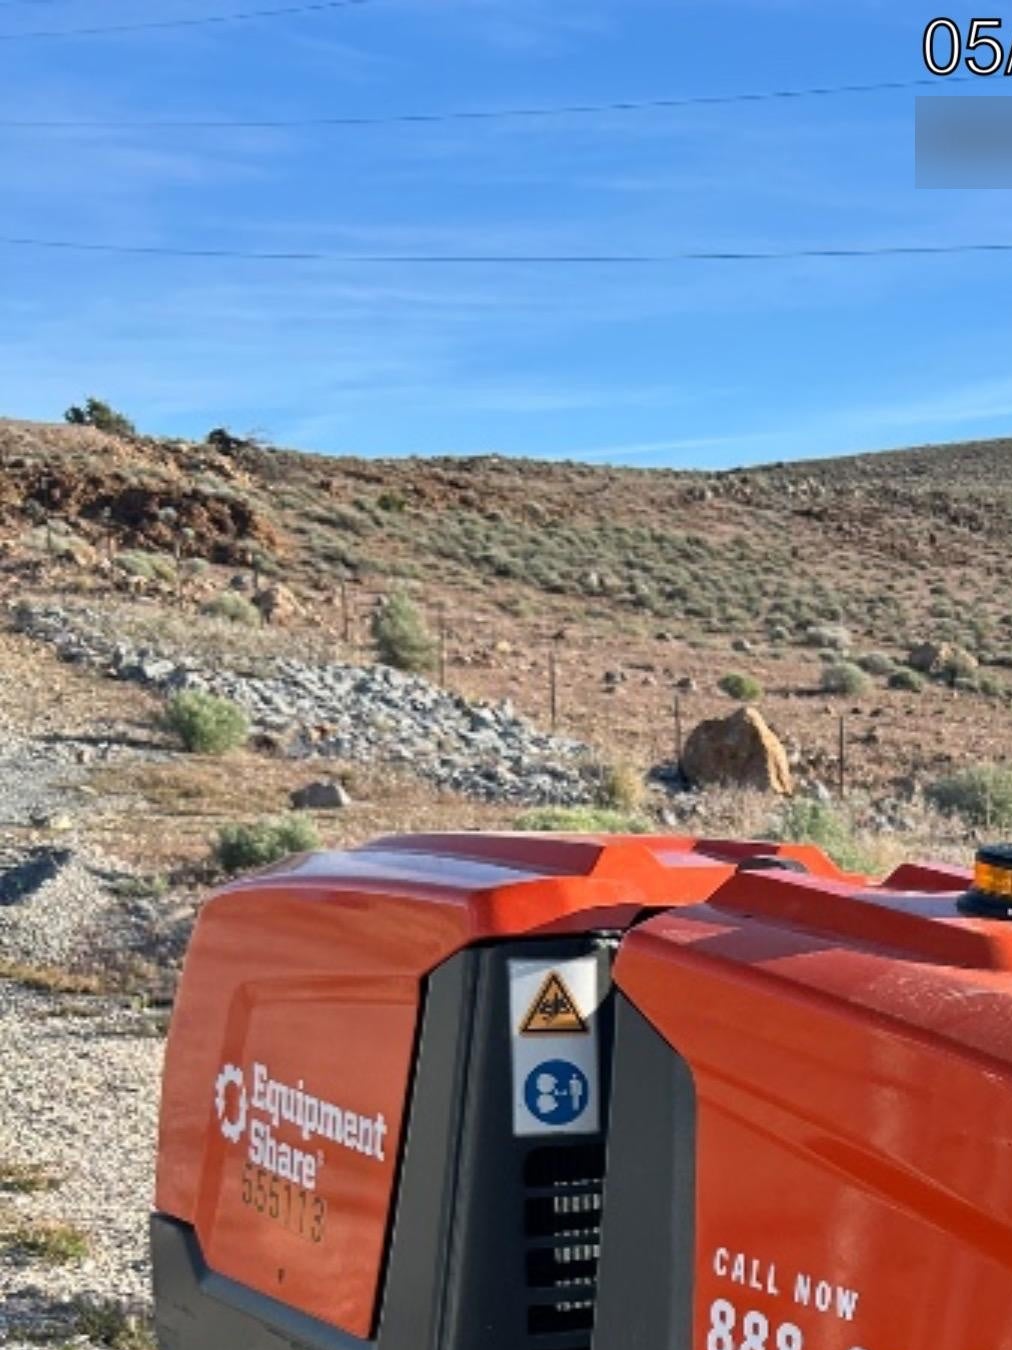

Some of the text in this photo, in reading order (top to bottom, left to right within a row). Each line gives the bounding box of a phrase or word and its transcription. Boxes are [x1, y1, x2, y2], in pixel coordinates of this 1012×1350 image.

[251, 1062, 387, 1162] Equipment
[713, 1247, 859, 1321] CALL NOW
